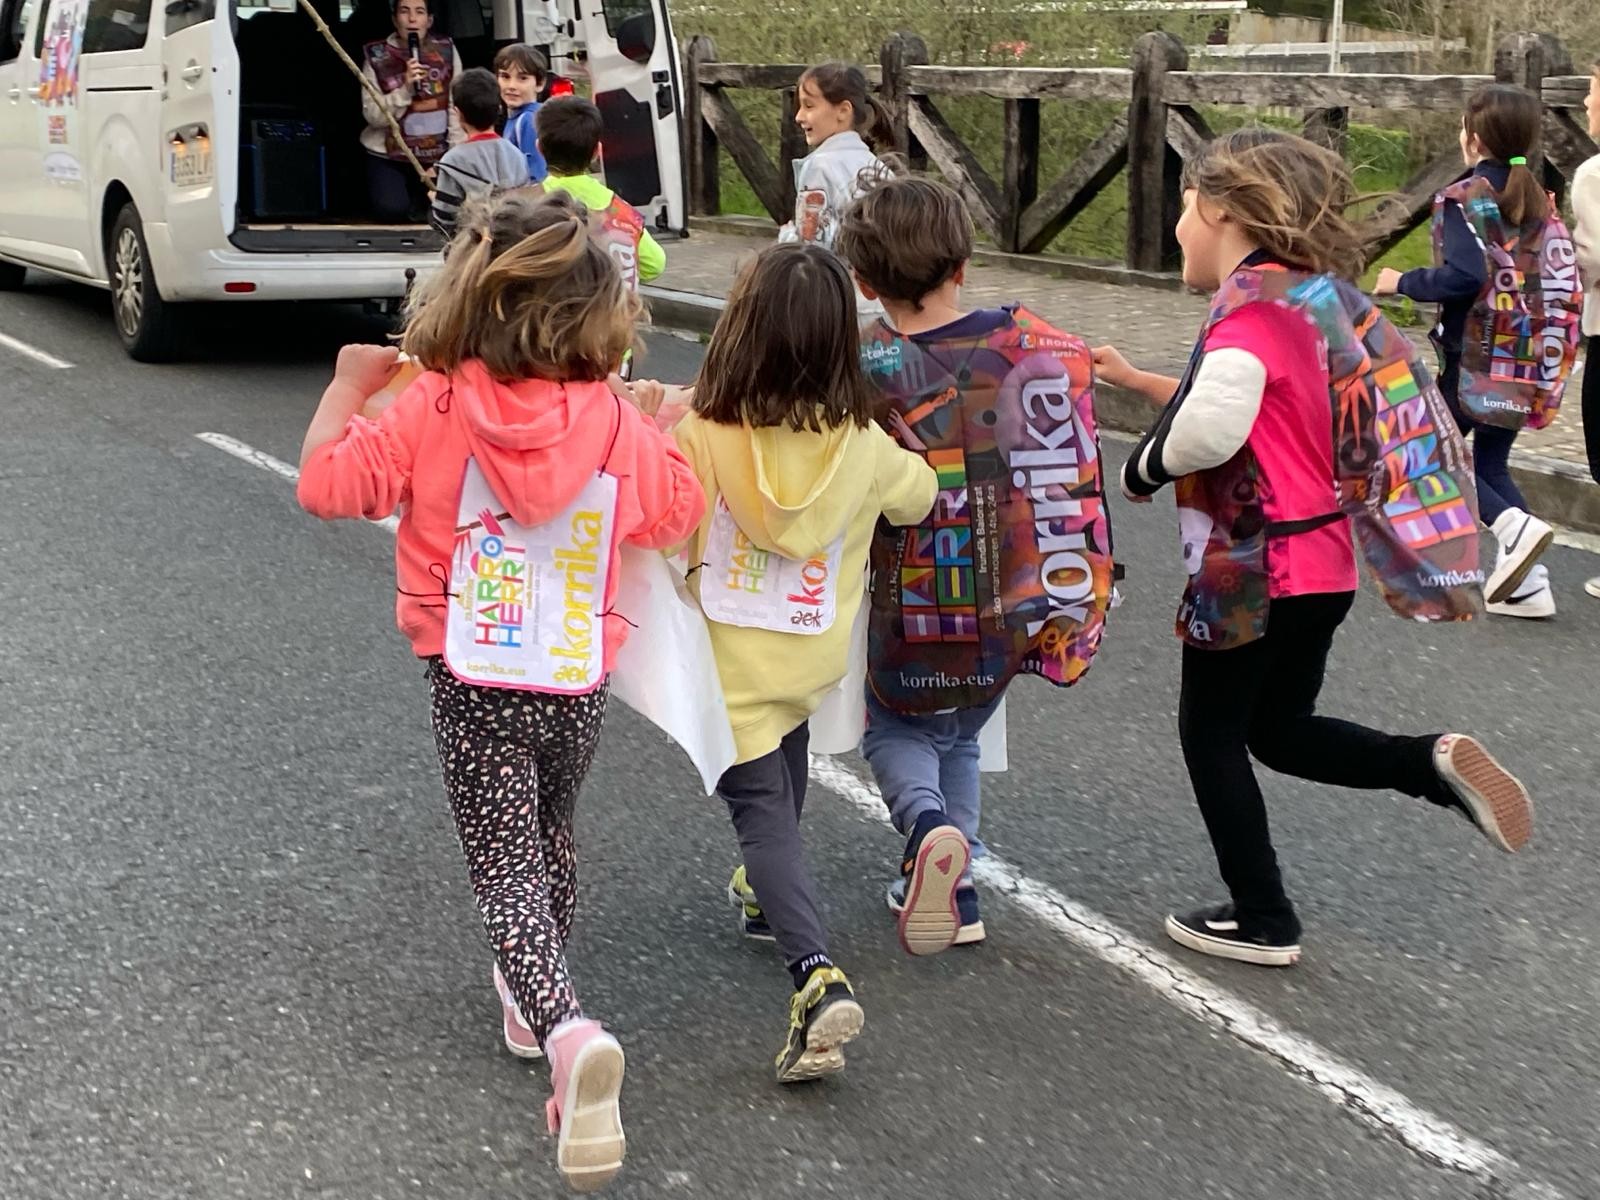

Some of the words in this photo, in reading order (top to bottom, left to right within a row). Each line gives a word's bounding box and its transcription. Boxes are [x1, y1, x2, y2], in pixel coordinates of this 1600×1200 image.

[1537, 238, 1577, 390] korrika
[977, 537, 988, 574] Irundik
[1009, 373, 1096, 637] korrika
[475, 535, 504, 646] HARRO
[496, 546, 526, 648] HERRI
[549, 510, 604, 661] korrika
[790, 608, 824, 628] aek
[900, 671, 996, 690] korrika.eus
